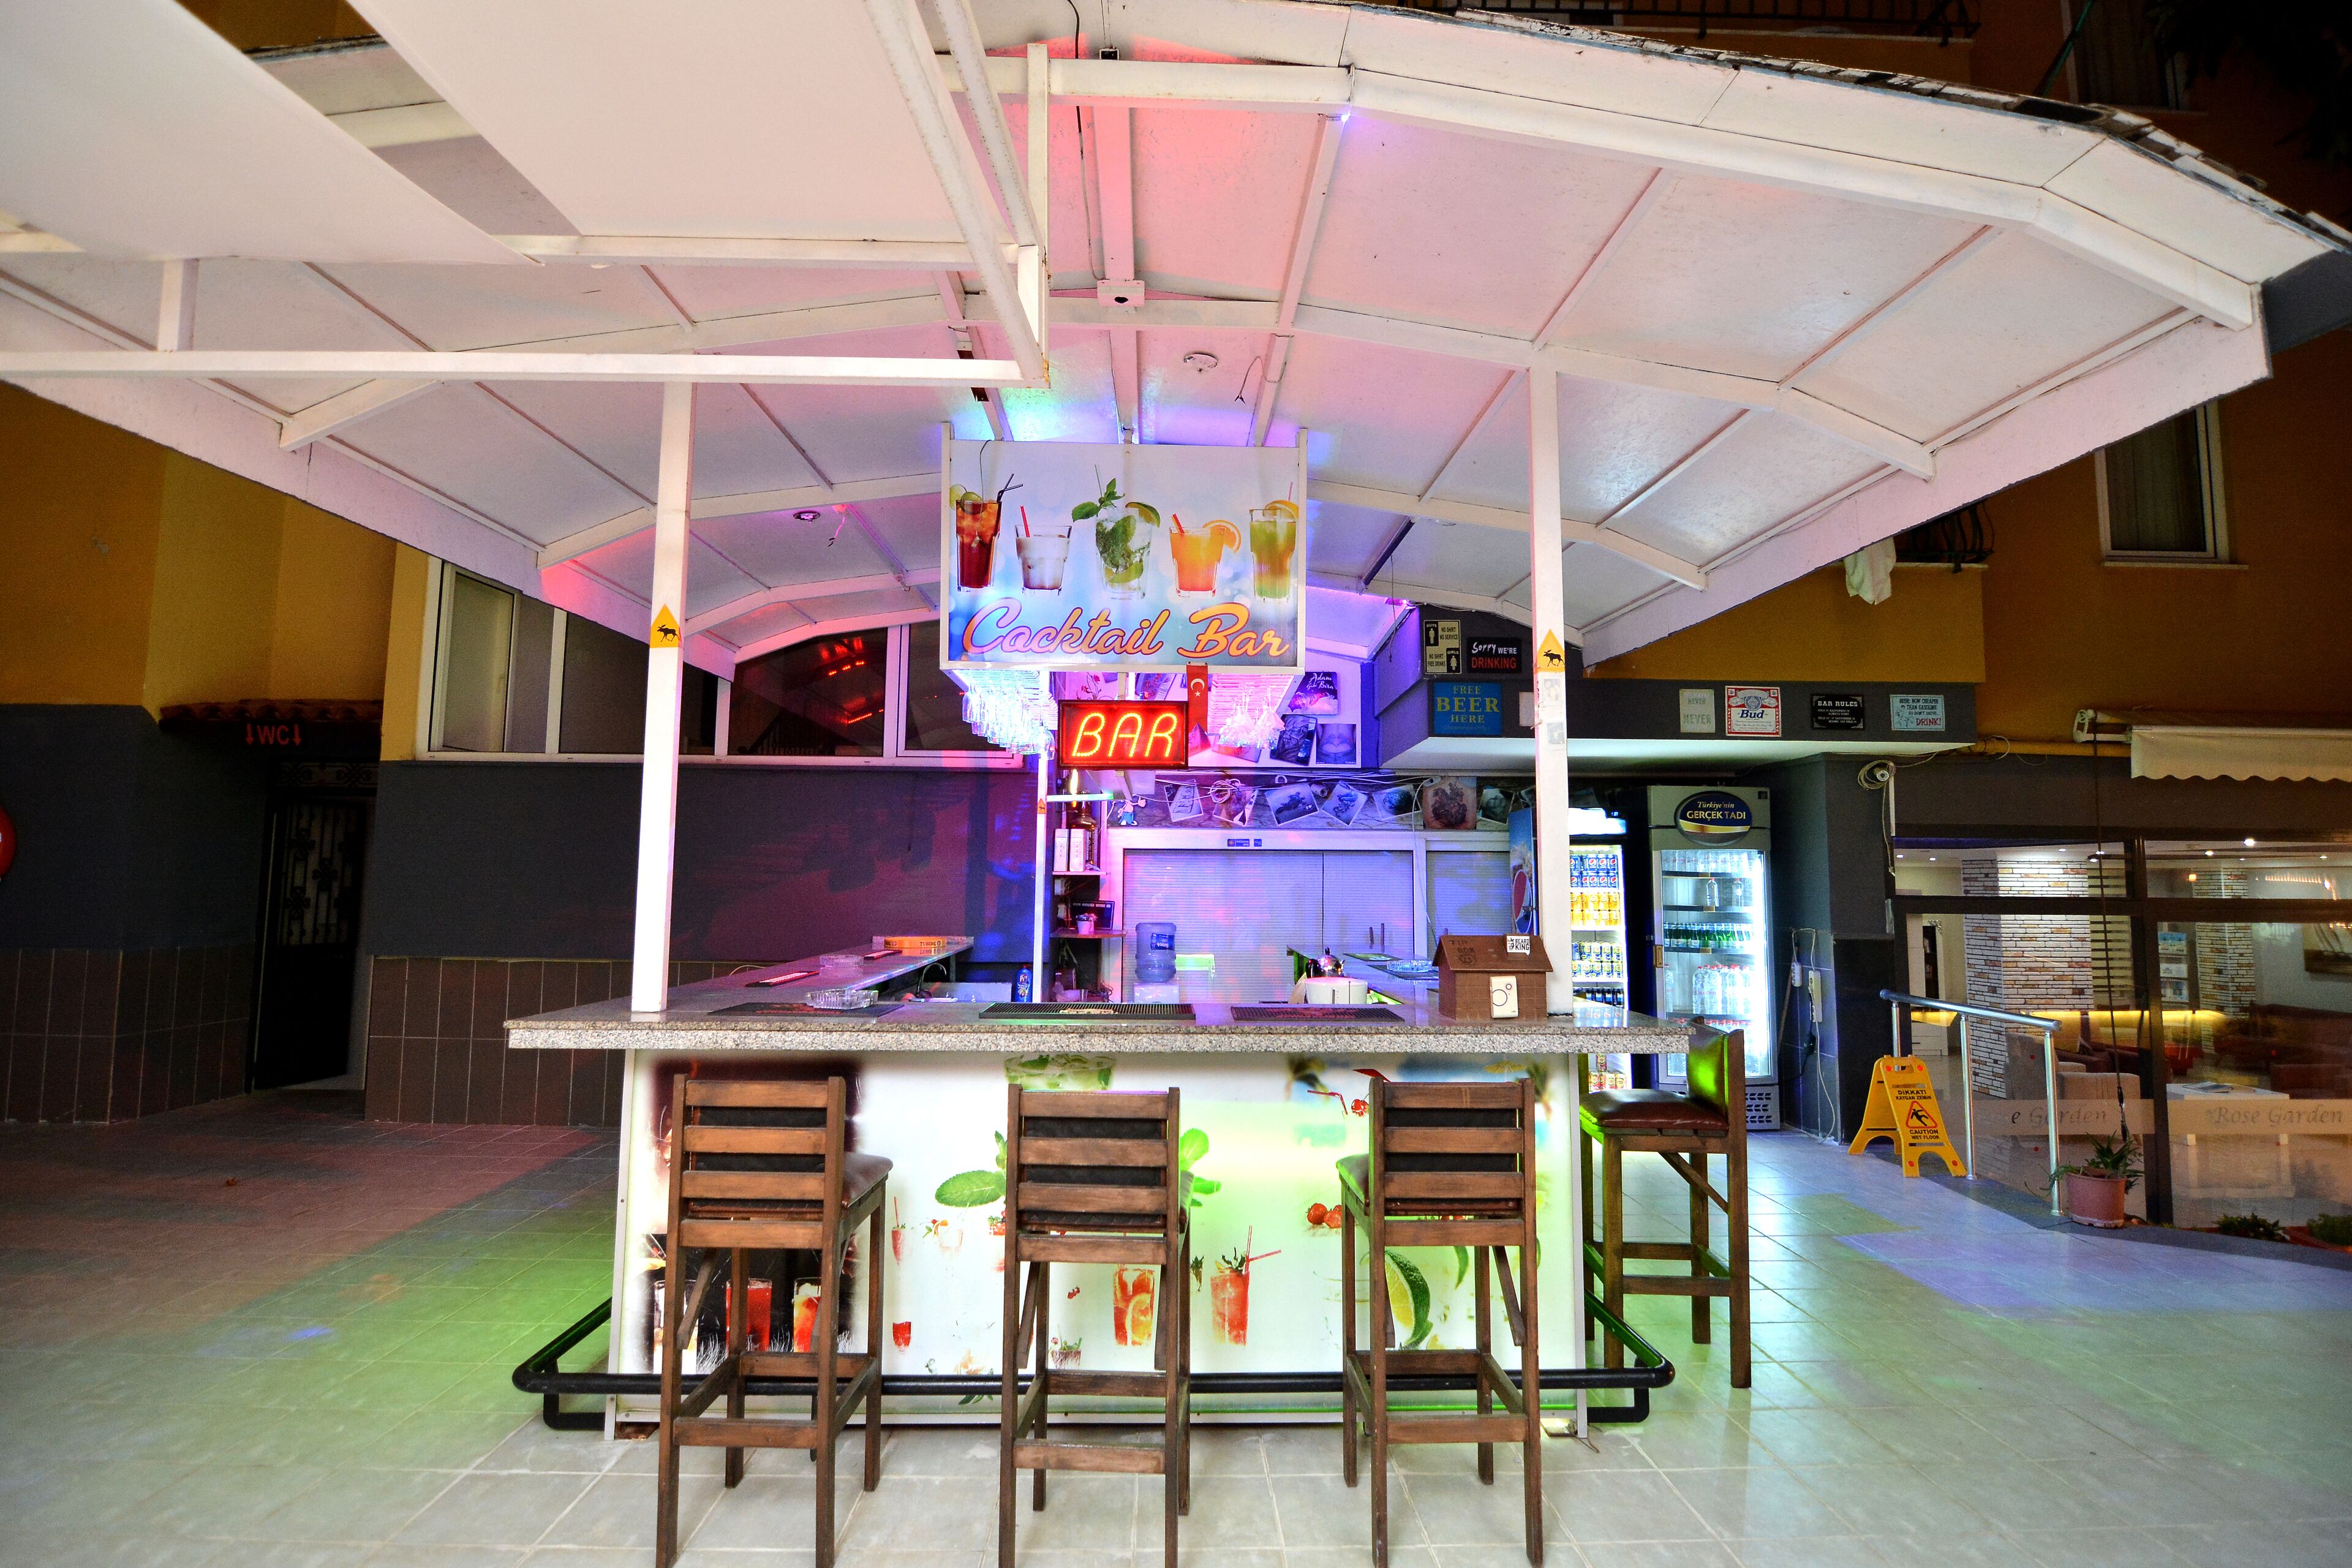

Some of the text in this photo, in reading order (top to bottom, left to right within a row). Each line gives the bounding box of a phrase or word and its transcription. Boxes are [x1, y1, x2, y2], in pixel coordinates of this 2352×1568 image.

[962, 597, 1291, 658] Cocktail Bar
[1472, 657, 1517, 669] DRINKING
[1453, 685, 1482, 695] FREE
[1436, 697, 1500, 712] BEER
[1451, 715, 1485, 723] HERE
[1683, 714, 1712, 725] NEVER
[1740, 710, 1765, 718] Bud
[257, 725, 290, 745] WC
[1071, 712, 1178, 758] BAR
[1697, 801, 1735, 810] Türkiye'nin
[1687, 811, 1723, 821] GERÇEK
[2214, 1104, 2342, 1127] Rose Garden
